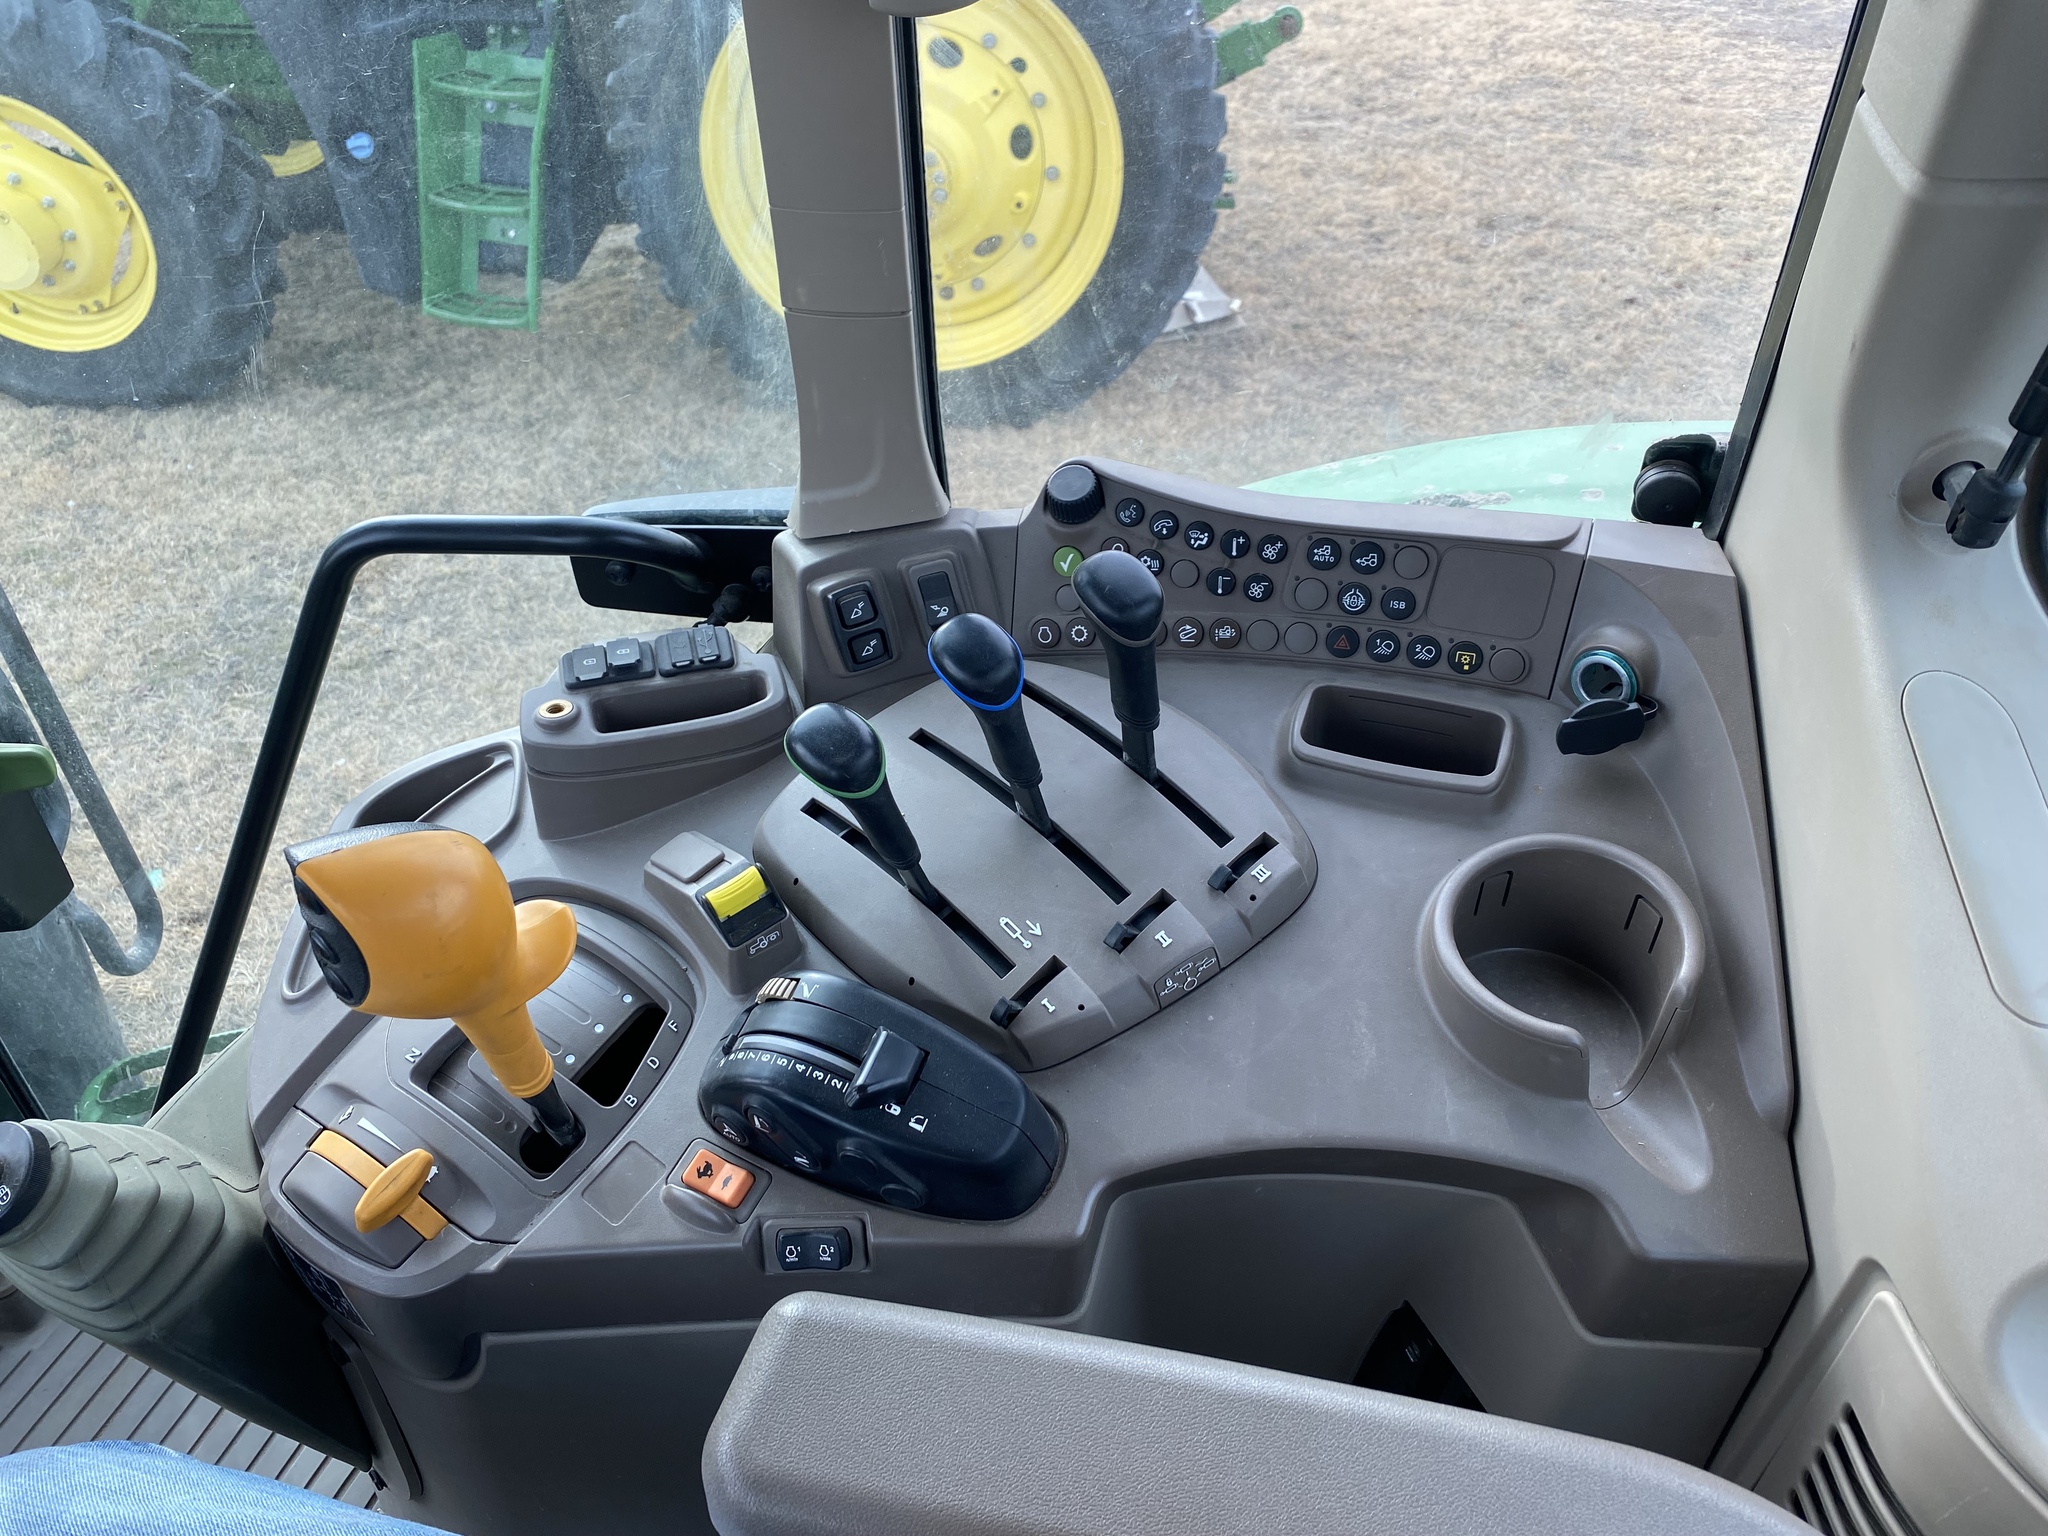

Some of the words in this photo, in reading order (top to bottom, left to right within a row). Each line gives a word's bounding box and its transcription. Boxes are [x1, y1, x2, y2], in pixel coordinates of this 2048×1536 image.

[1313, 554, 1335, 563] AUTO
[1389, 600, 1406, 609] ISB
[1376, 638, 1381, 646] 1
[1415, 644, 1421, 652] 2
[1250, 863, 1272, 883] III
[1154, 930, 1173, 948] II
[1040, 997, 1056, 1013] I
[667, 1019, 678, 1032] F
[404, 1046, 422, 1063] N
[646, 1056, 660, 1070] D
[737, 1051, 745, 1059] 8
[747, 1052, 756, 1060] 7
[761, 1053, 771, 1062] 6
[776, 1056, 788, 1067] 5
[795, 1063, 806, 1073] 4
[812, 1070, 824, 1081] 3
[831, 1078, 843, 1089] 2
[624, 1094, 638, 1108] B
[723, 1131, 741, 1142] AUTO
